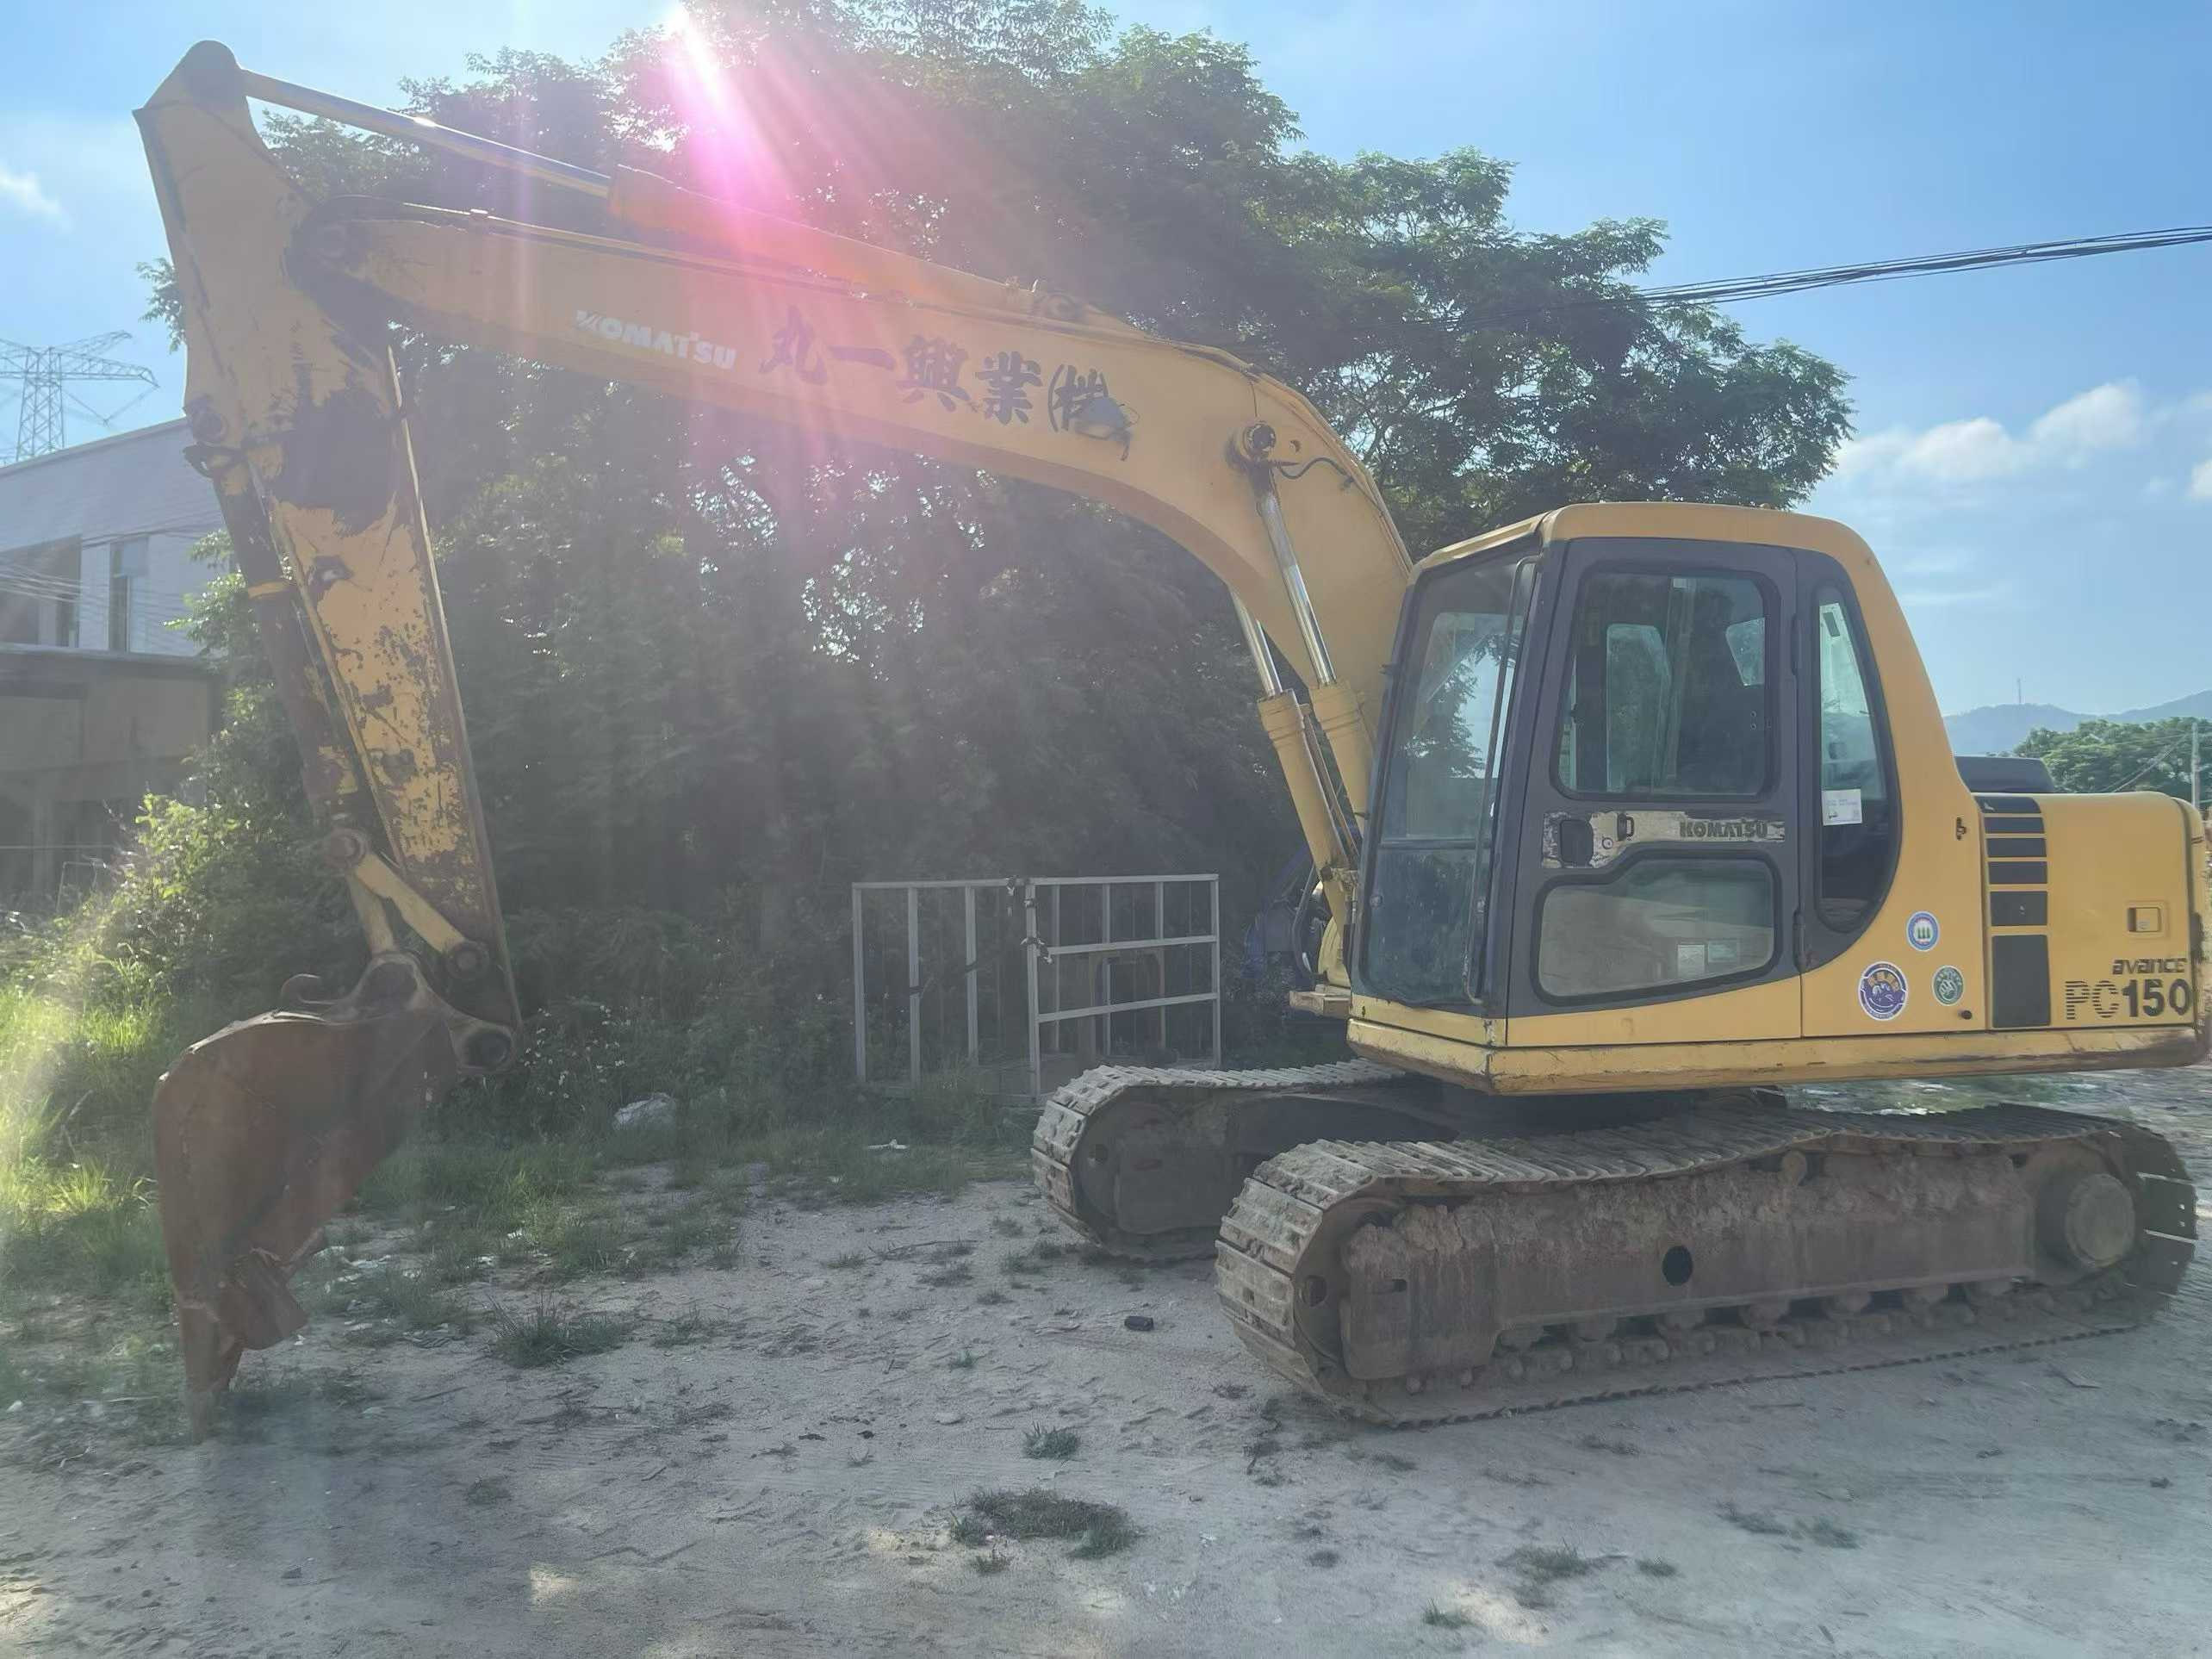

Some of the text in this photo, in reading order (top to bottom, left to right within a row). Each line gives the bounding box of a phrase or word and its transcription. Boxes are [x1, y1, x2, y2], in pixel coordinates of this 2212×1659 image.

[576, 309, 737, 370] KOMATSU
[1680, 817, 1768, 838] KOMATSU
[2065, 979, 2191, 1020] PC150
